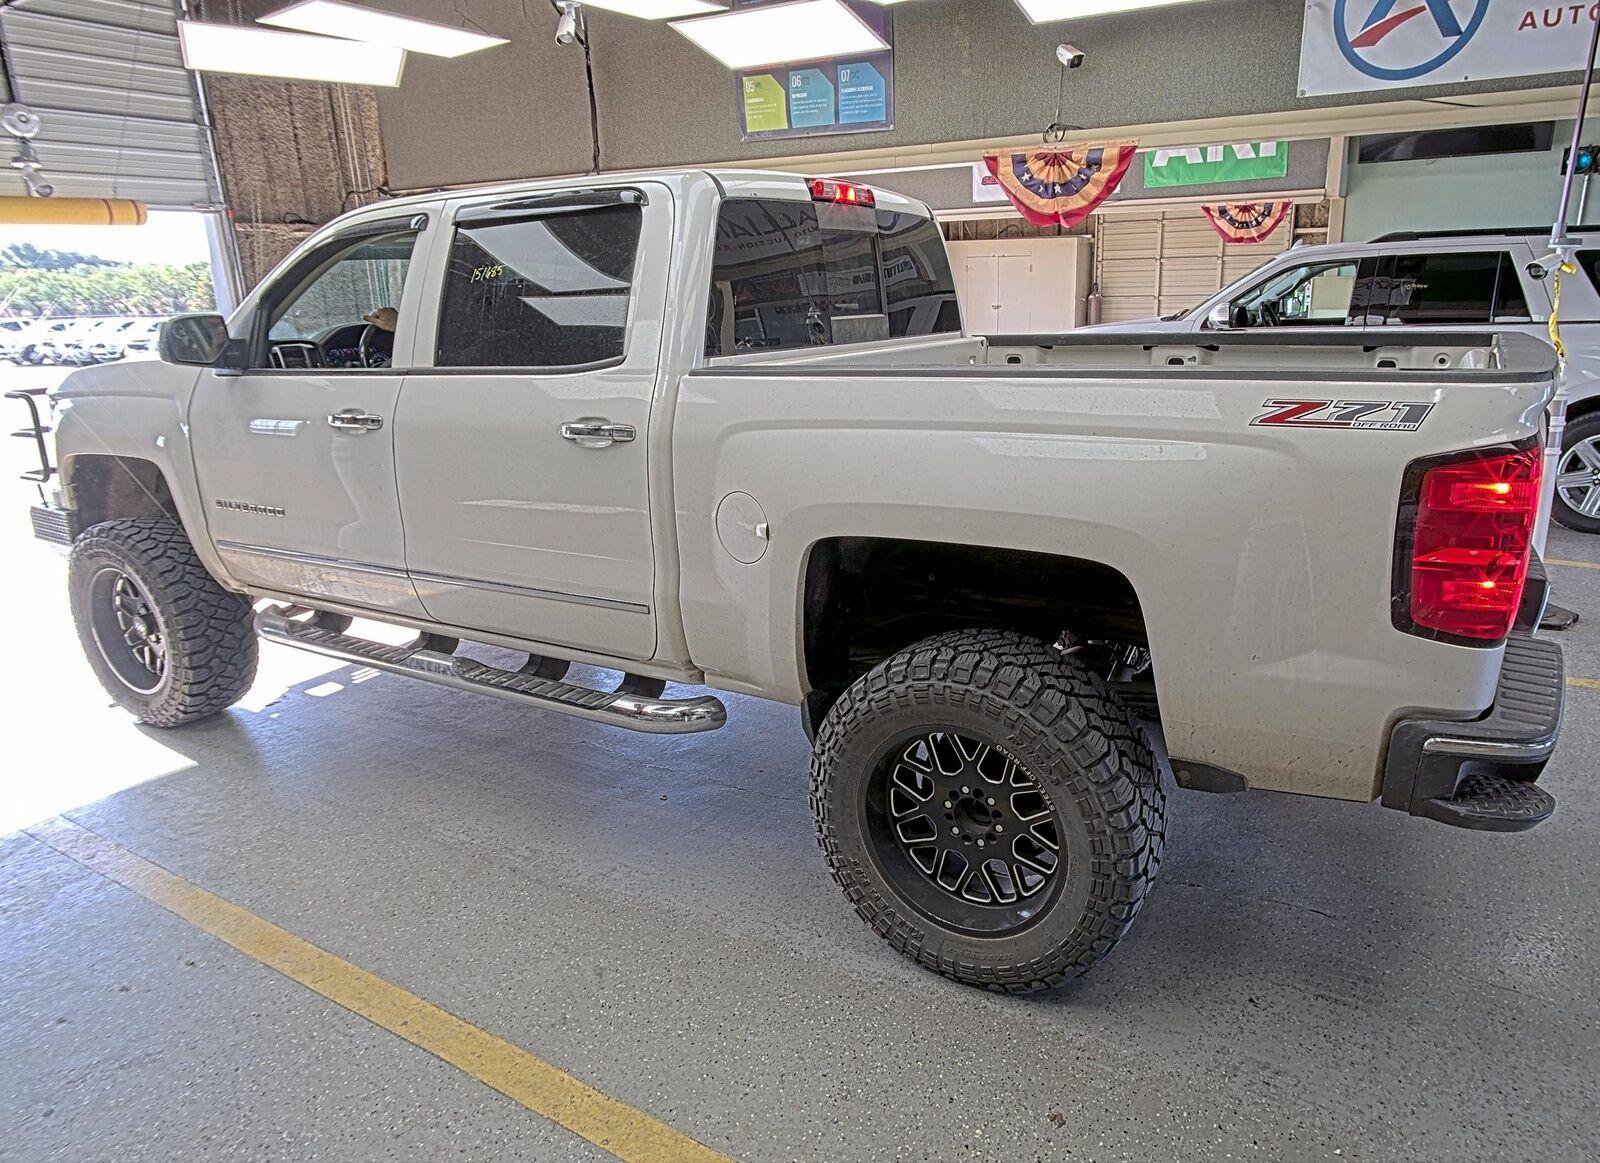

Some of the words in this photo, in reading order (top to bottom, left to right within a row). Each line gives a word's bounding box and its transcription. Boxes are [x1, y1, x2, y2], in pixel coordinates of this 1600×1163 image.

[791, 75, 802, 88] 06
[840, 69, 851, 82] 07
[745, 81, 755, 93] 05
[1249, 398, 1437, 431] Z71
[215, 499, 286, 517] SILVERADO
[1037, 782, 1056, 812] STEEL
